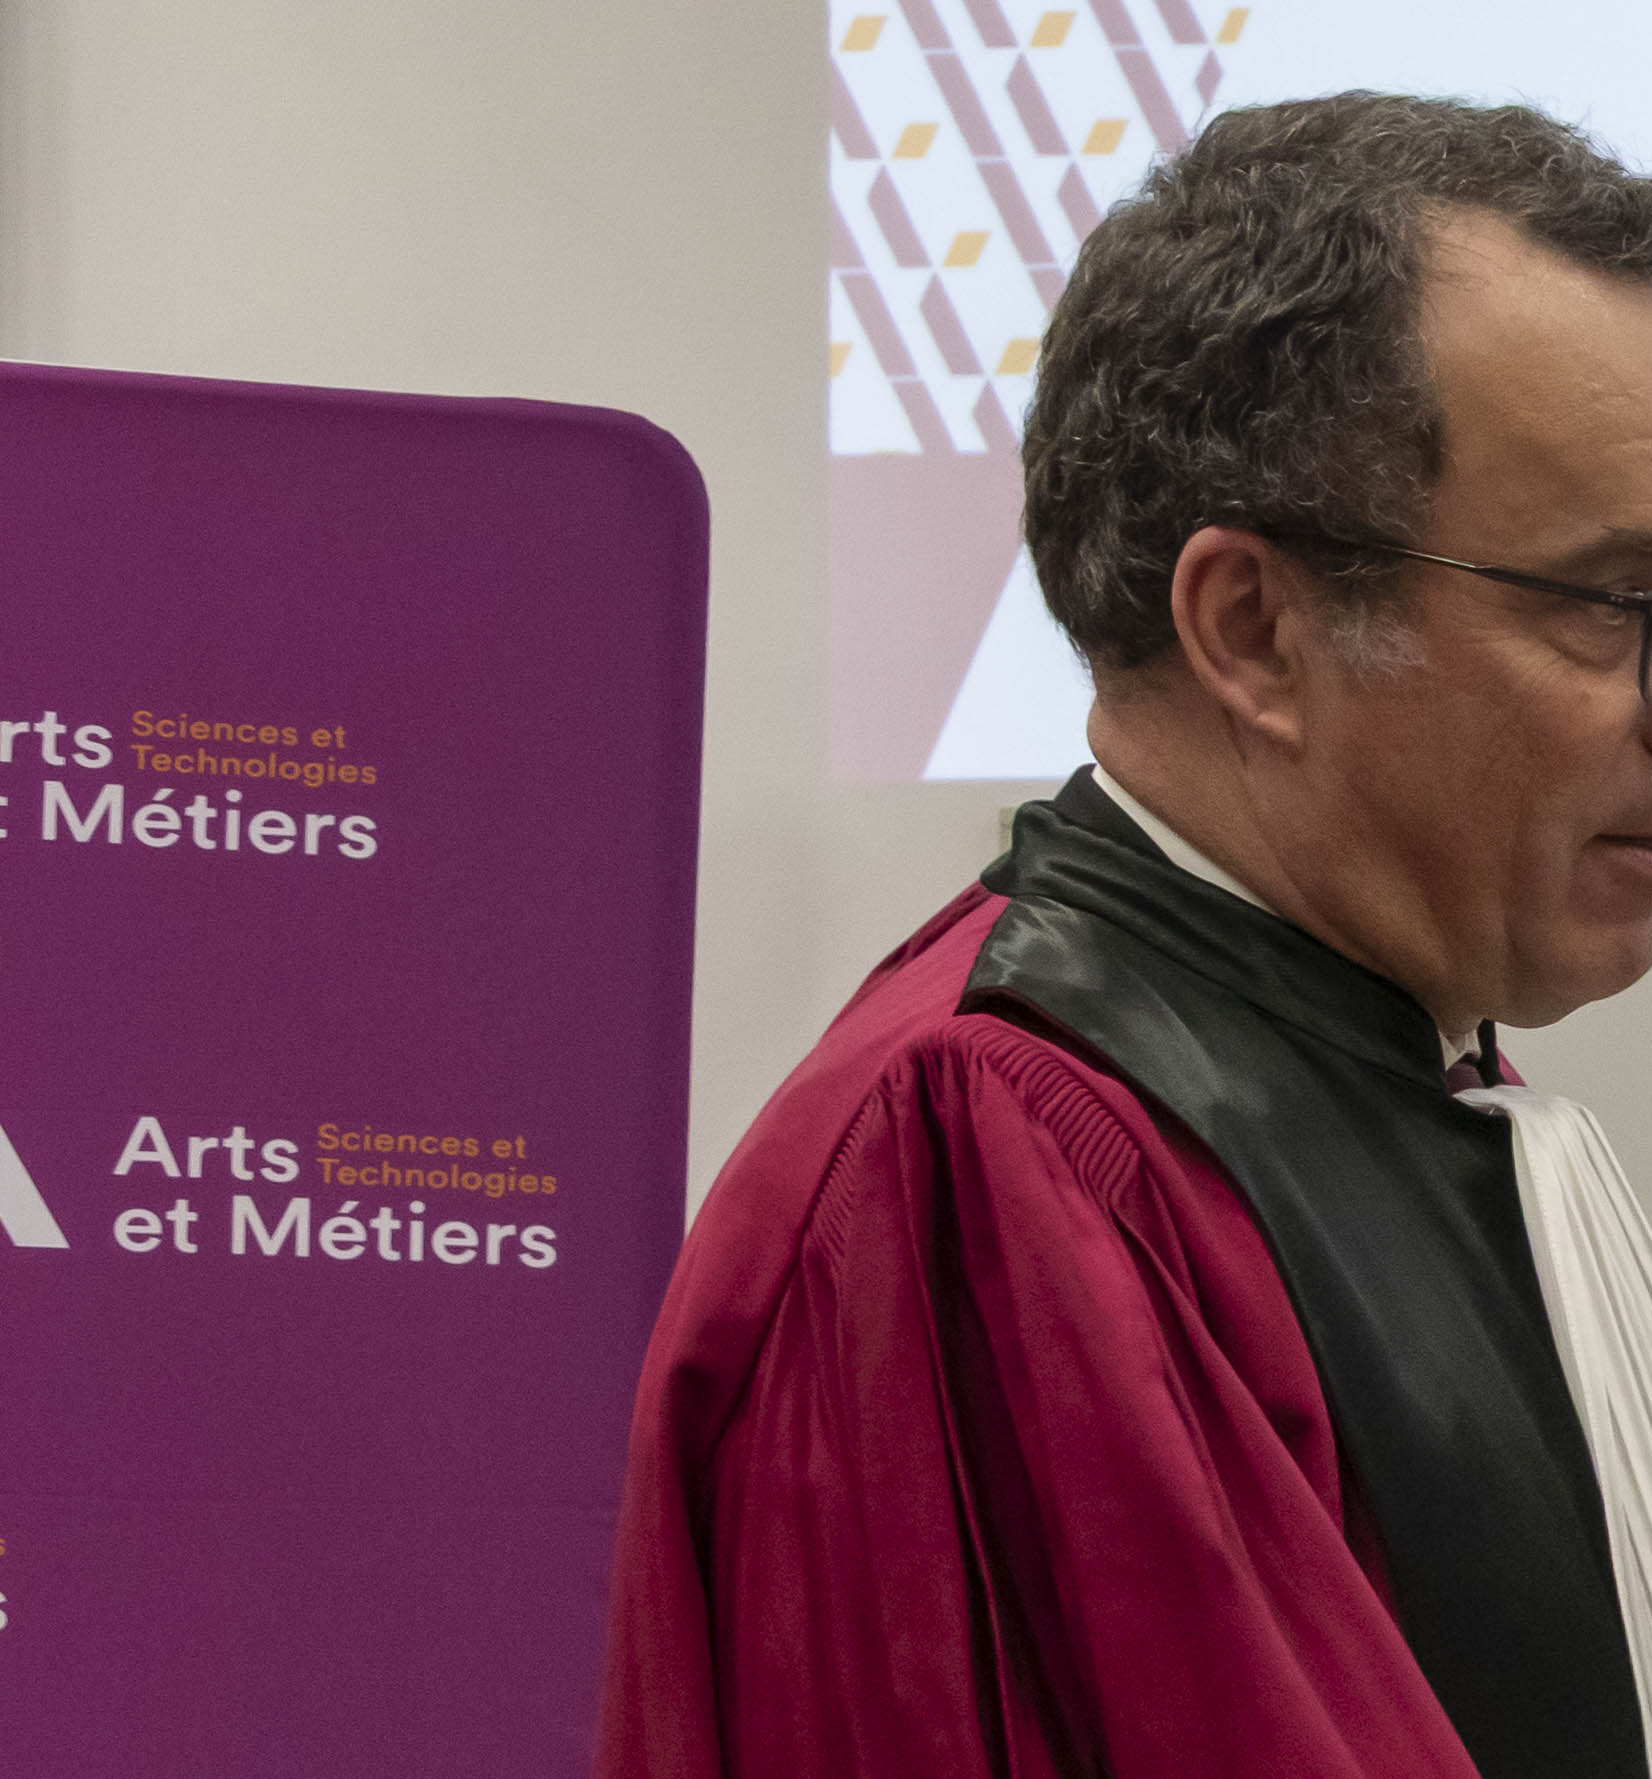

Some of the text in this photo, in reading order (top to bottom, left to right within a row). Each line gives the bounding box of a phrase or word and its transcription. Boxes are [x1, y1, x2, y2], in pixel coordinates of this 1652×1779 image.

[0, 711, 112, 768] rts
[131, 709, 346, 748] Sciences et
[131, 744, 377, 787] Technologies
[43, 781, 377, 859] Métiers
[114, 1116, 299, 1182] Arts
[318, 1124, 526, 1159] Sciences et
[318, 1158, 557, 1197] Technologies
[114, 1195, 557, 1268] et Métiers
